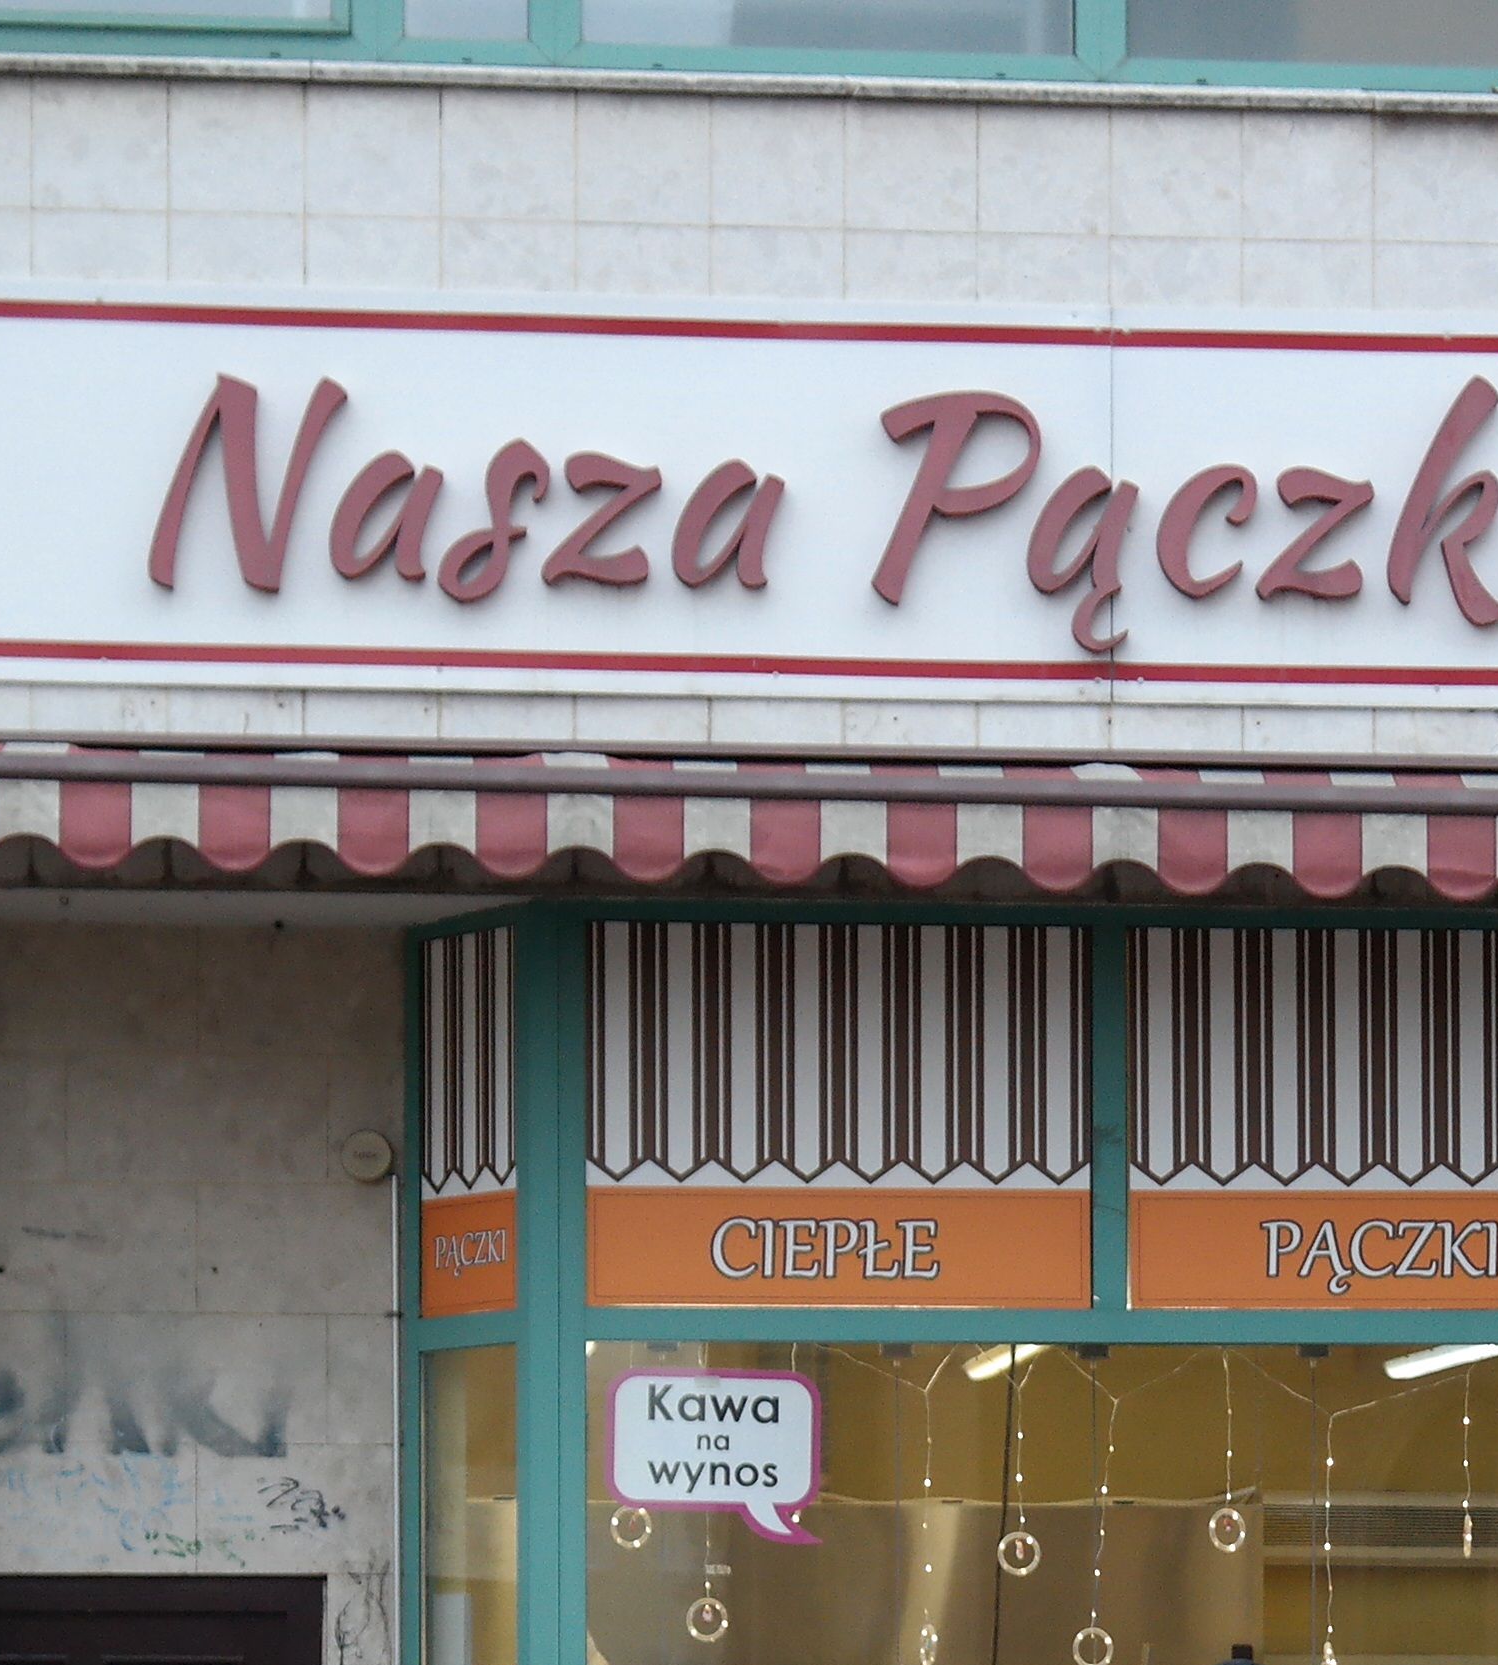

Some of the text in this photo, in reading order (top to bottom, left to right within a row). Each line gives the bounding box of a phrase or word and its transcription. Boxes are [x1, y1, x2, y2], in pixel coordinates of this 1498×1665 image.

[147, 373, 787, 603] Nasza
[434, 1228, 508, 1277] PĄCZKI
[711, 1215, 941, 1281] CIEPŁE
[646, 1382, 780, 1425] Kawa
[696, 1432, 730, 1452] na
[647, 1458, 779, 1494] wynos
